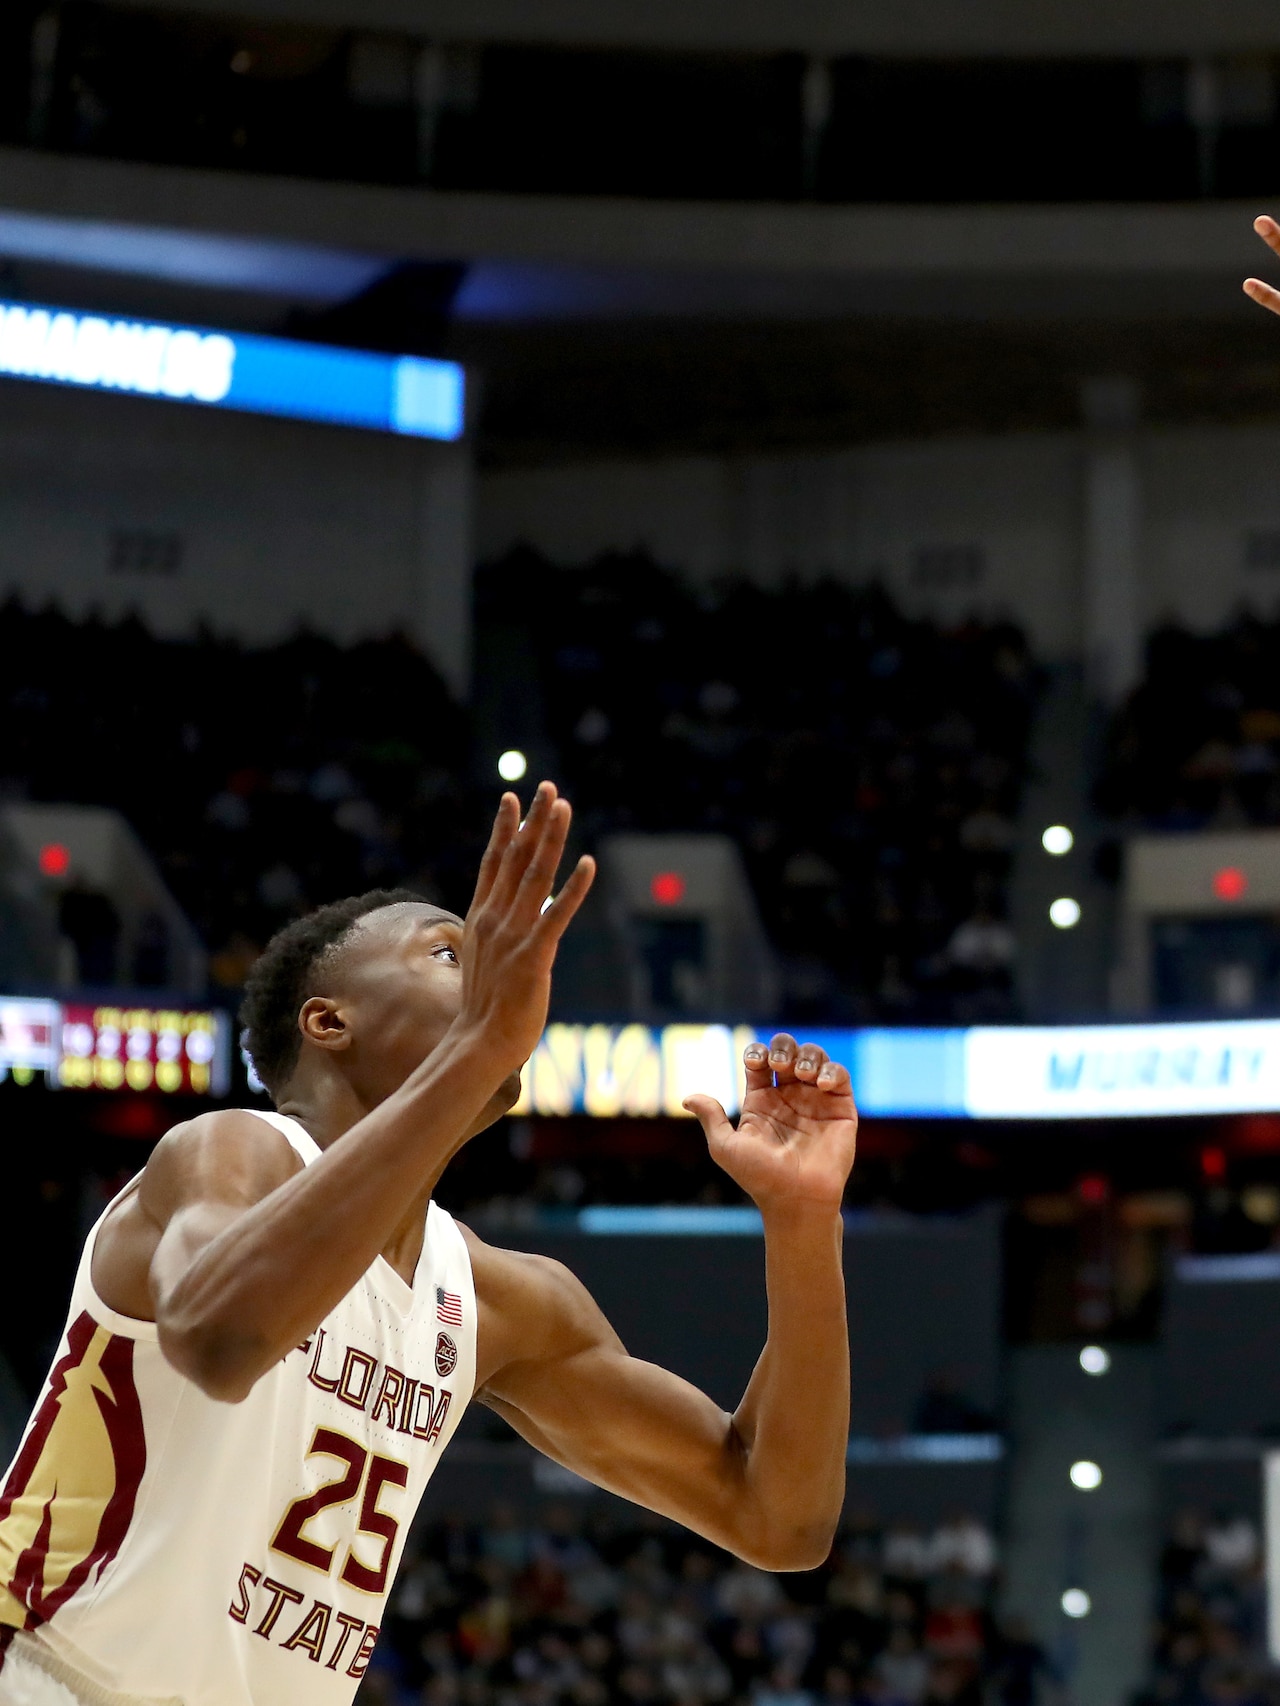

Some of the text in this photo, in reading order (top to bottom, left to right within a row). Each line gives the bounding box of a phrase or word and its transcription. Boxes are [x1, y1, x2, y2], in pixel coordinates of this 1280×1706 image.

[1046, 1043, 1265, 1093] MURRAY
[290, 1328, 452, 1446] LORIDA
[438, 1345, 457, 1359] ACC
[268, 1424, 409, 1597] 25
[228, 1562, 381, 1679] STATE
